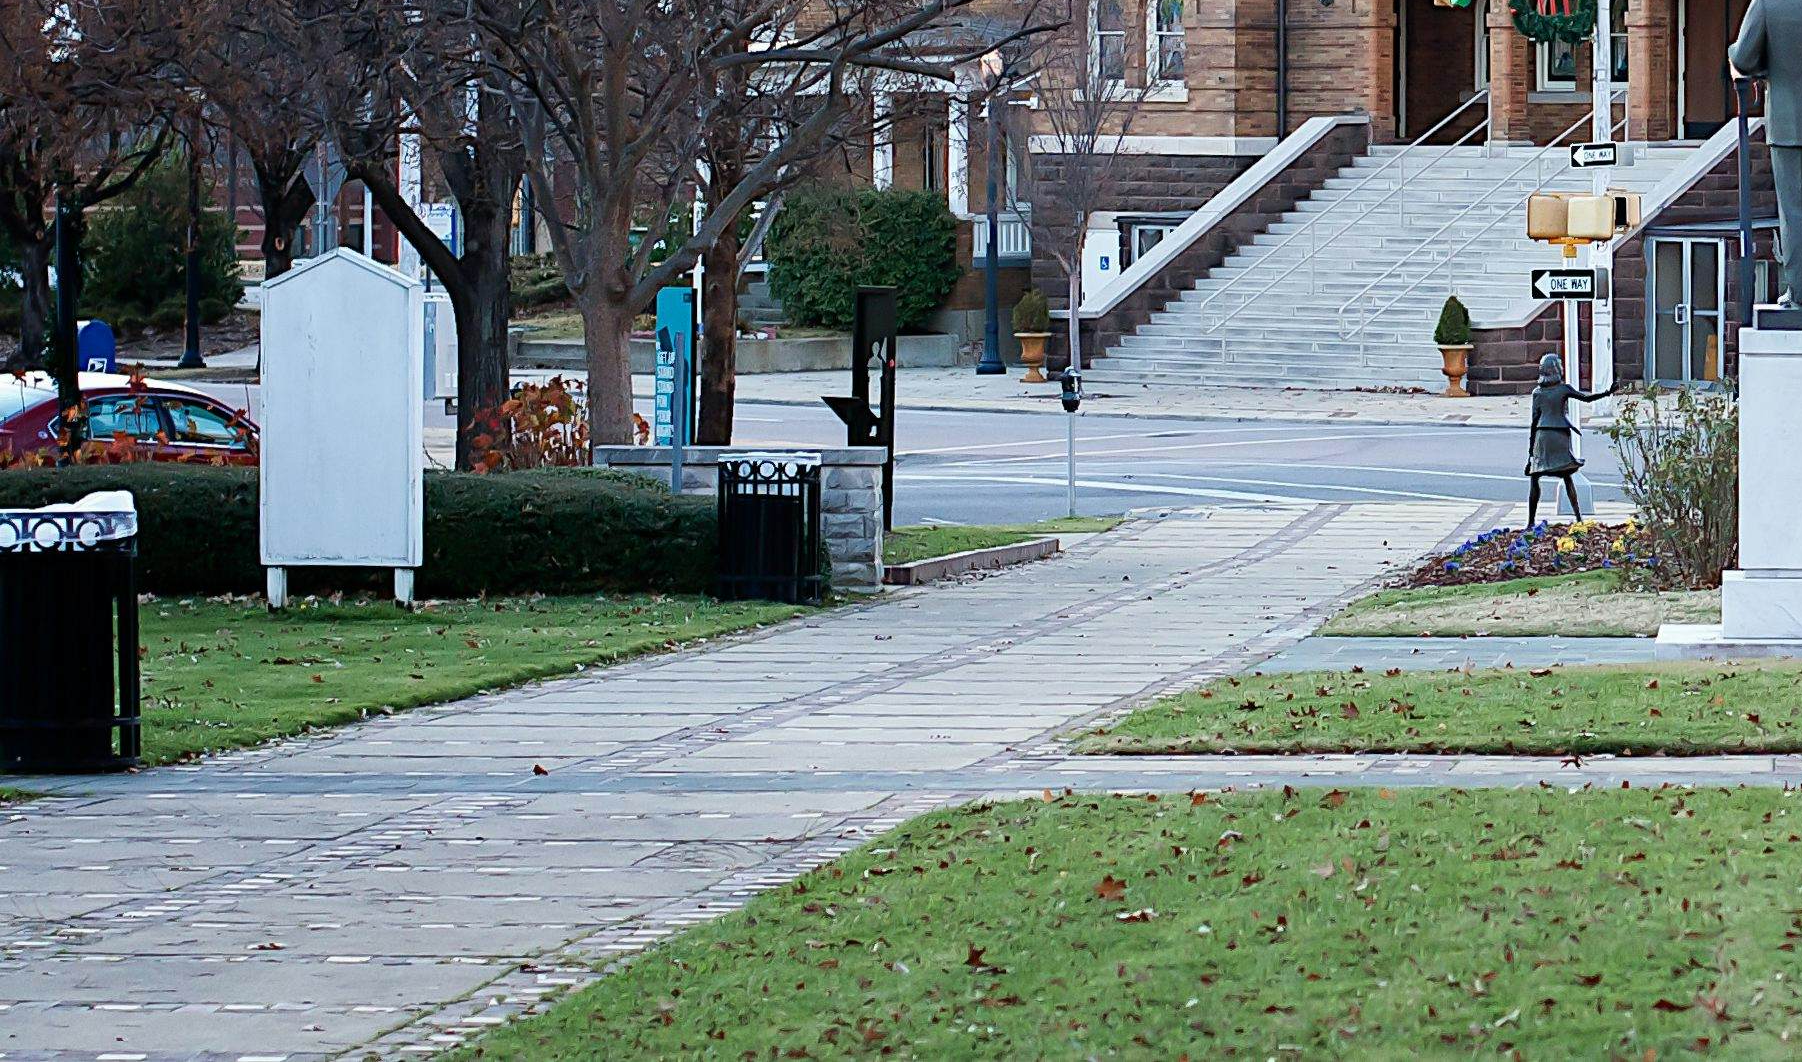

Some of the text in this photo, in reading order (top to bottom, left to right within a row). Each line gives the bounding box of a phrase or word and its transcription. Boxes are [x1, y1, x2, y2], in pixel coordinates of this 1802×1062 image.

[1584, 150, 1612, 160] ONE WAY
[1550, 278, 1588, 290] ONE WAY
